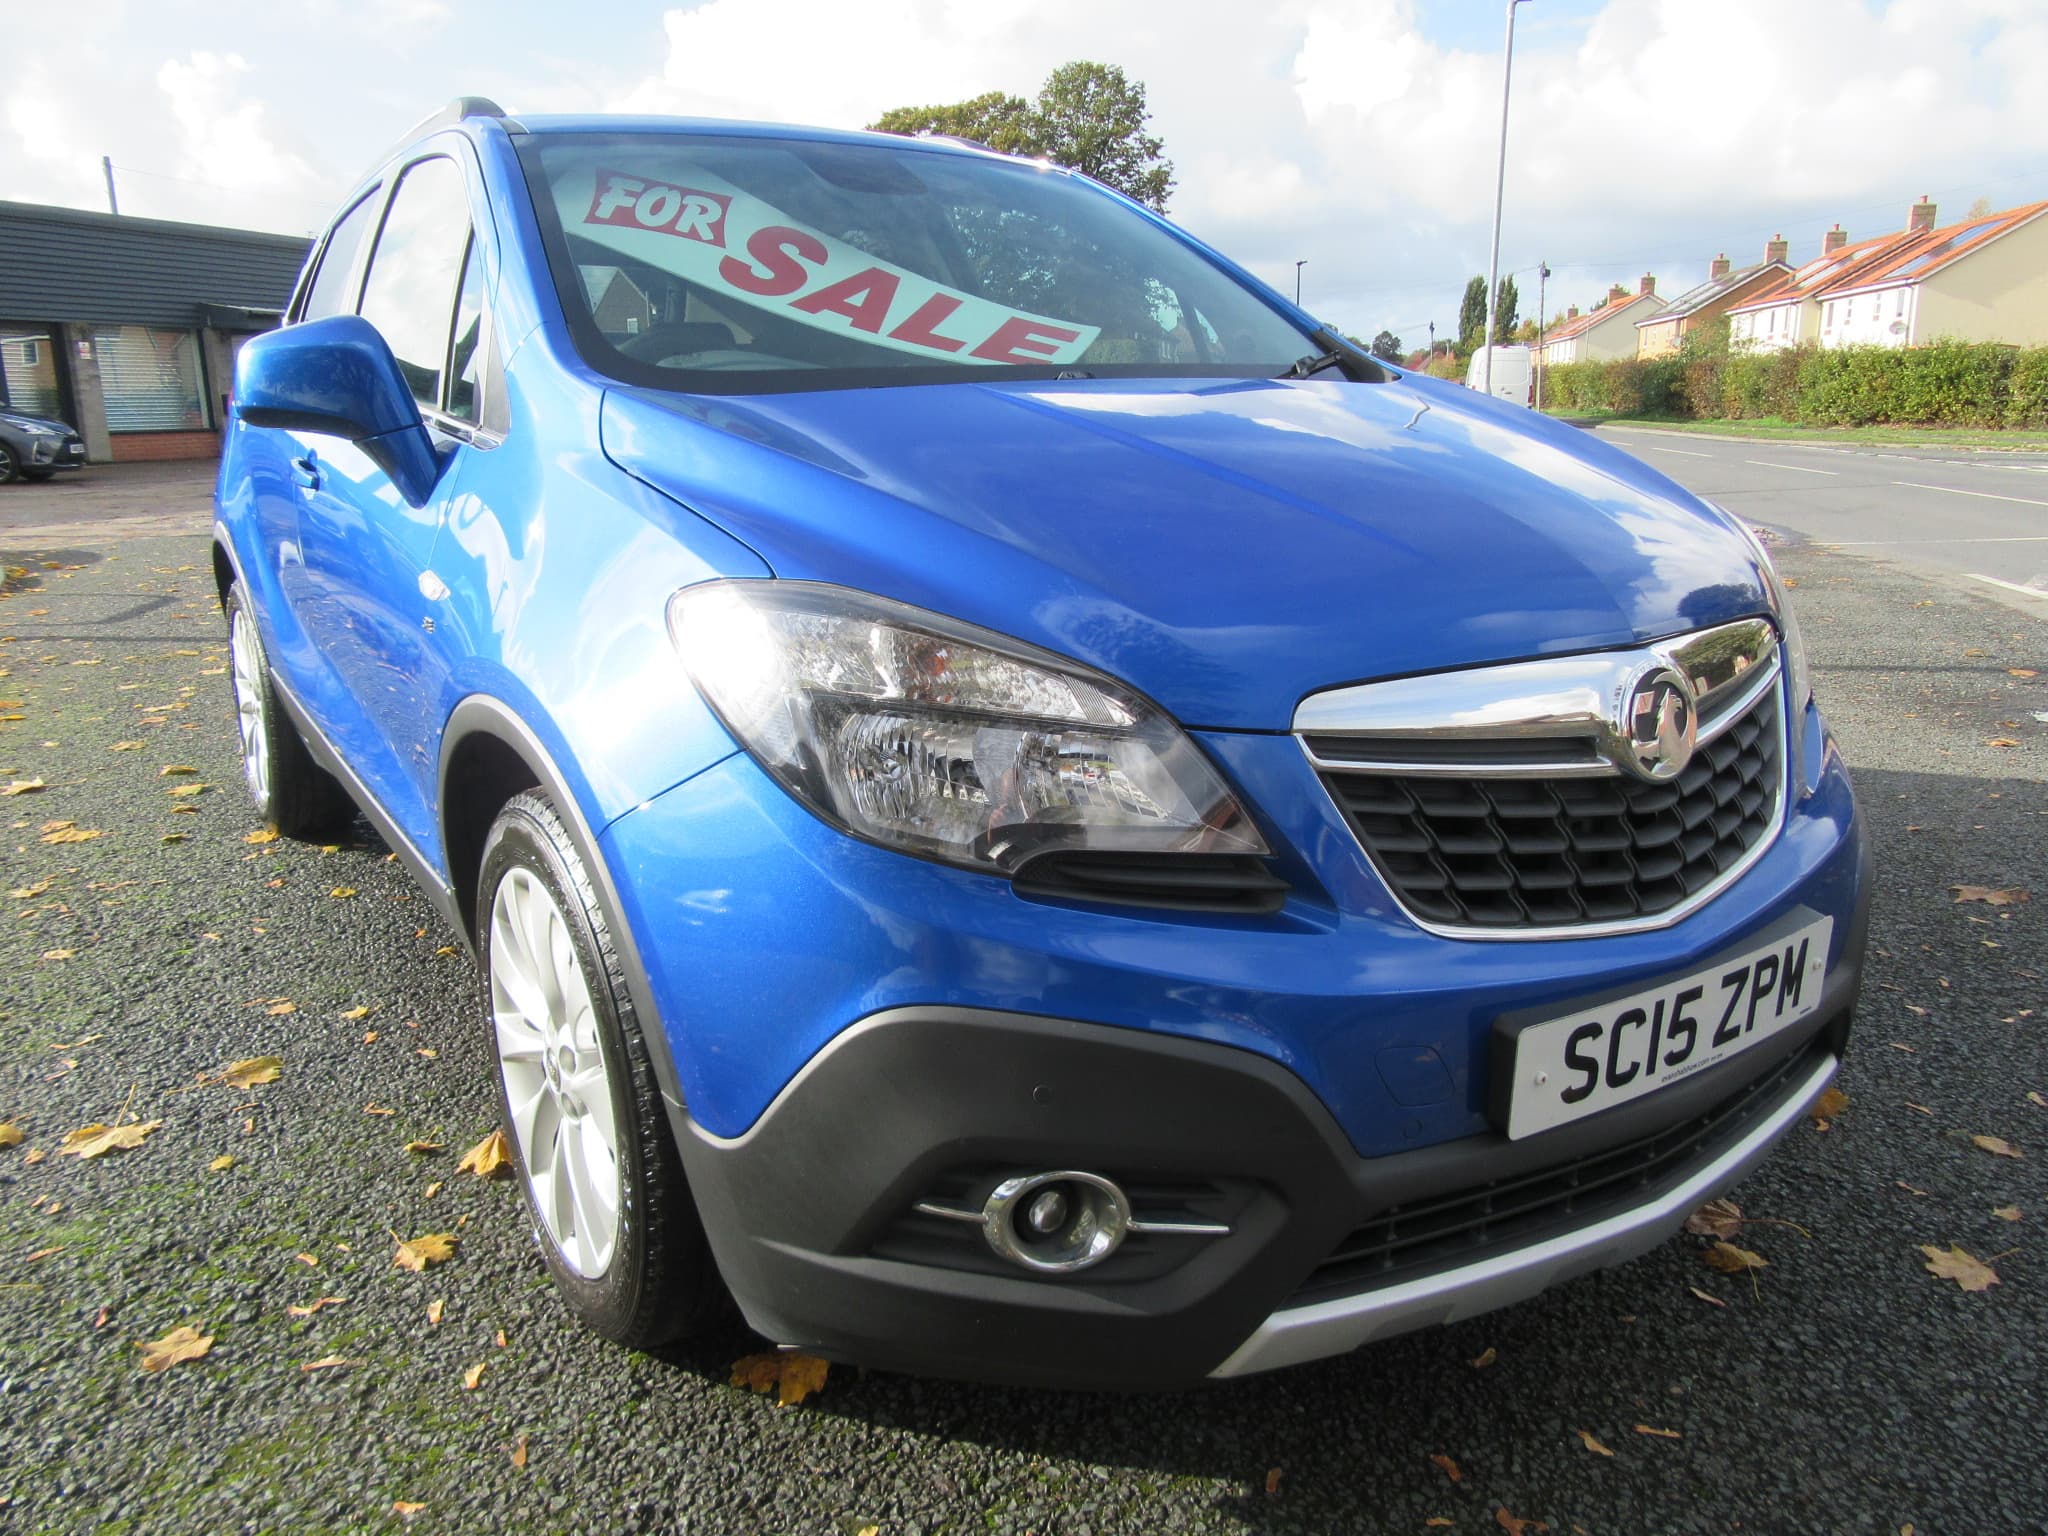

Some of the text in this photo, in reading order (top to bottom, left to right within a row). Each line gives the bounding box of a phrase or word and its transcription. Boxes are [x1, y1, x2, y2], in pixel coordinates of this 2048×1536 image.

[594, 176, 1081, 364] FOR SALE
[1560, 937, 1809, 1105] SC15 ZPM
